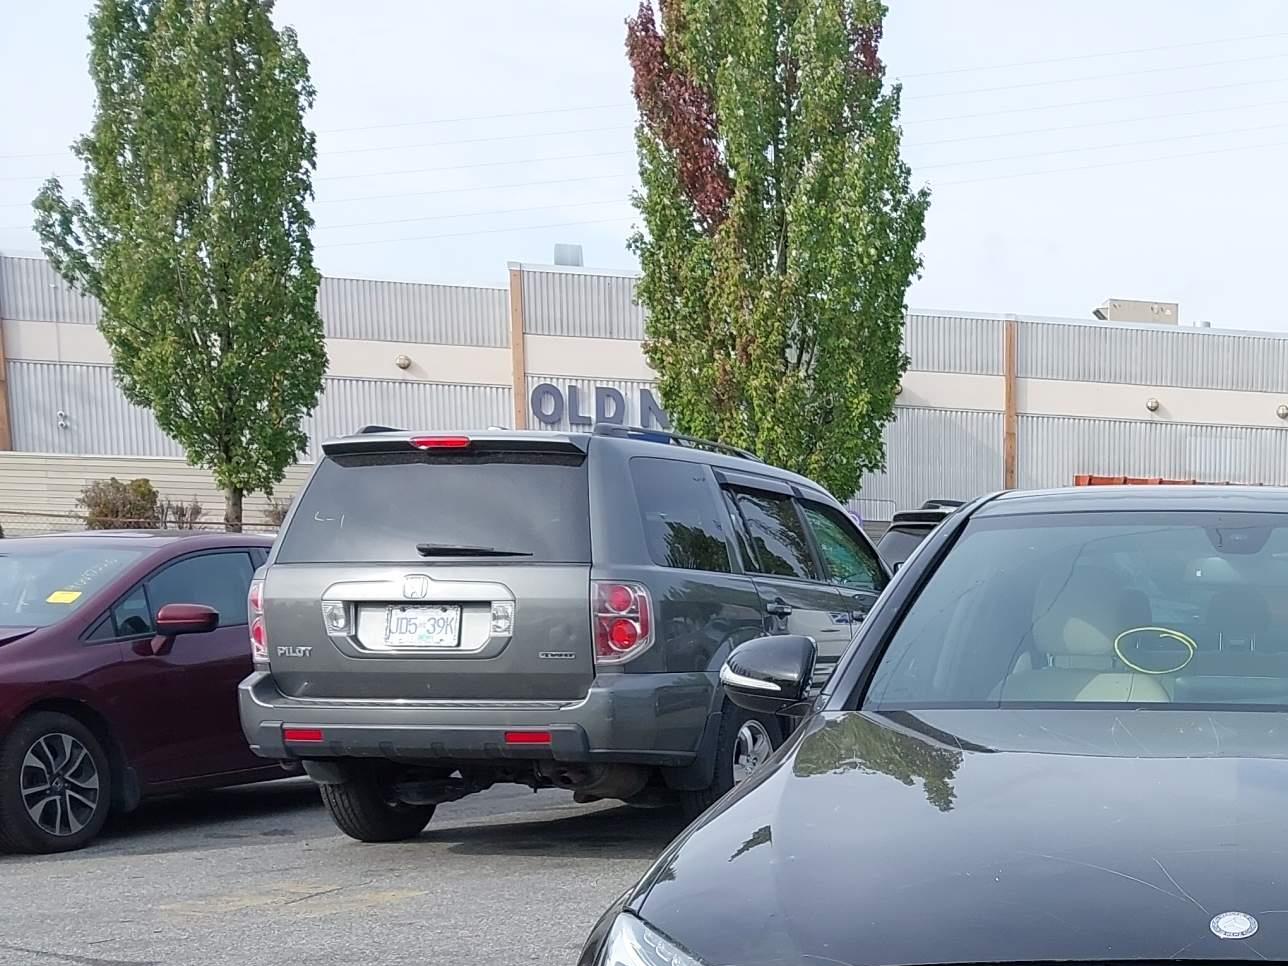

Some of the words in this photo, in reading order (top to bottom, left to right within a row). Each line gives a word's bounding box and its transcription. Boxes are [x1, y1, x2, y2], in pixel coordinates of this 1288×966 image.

[531, 382, 625, 425] OLD
[426, 616, 455, 635] 39K
[277, 646, 312, 656] PILOT
